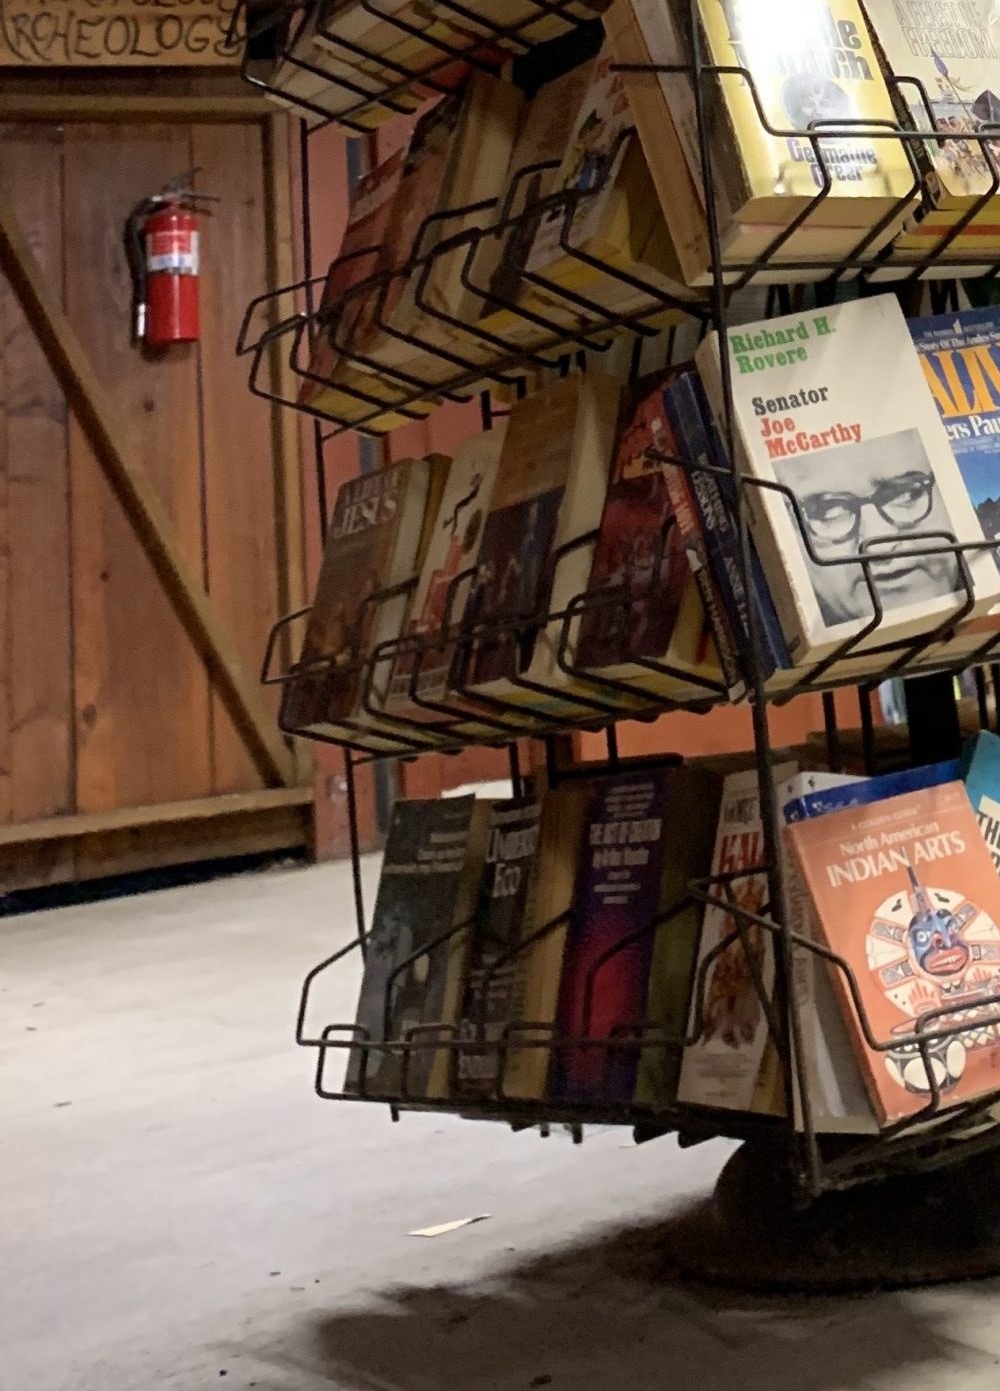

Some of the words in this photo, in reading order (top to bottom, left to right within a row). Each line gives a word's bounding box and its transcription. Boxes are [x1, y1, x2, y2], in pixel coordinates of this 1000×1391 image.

[902, 27, 998, 59] FREEDOM
[730, 320, 809, 355] Richard
[813, 316, 836, 337] H.
[736, 346, 808, 374] Rovere
[752, 386, 829, 416] Senator
[761, 417, 796, 437] Joe
[765, 423, 862, 458] McCarthy
[840, 833, 878, 856] North
[879, 821, 939, 847] American
[826, 847, 910, 888] INDIAN
[912, 830, 966, 865] ARTS
